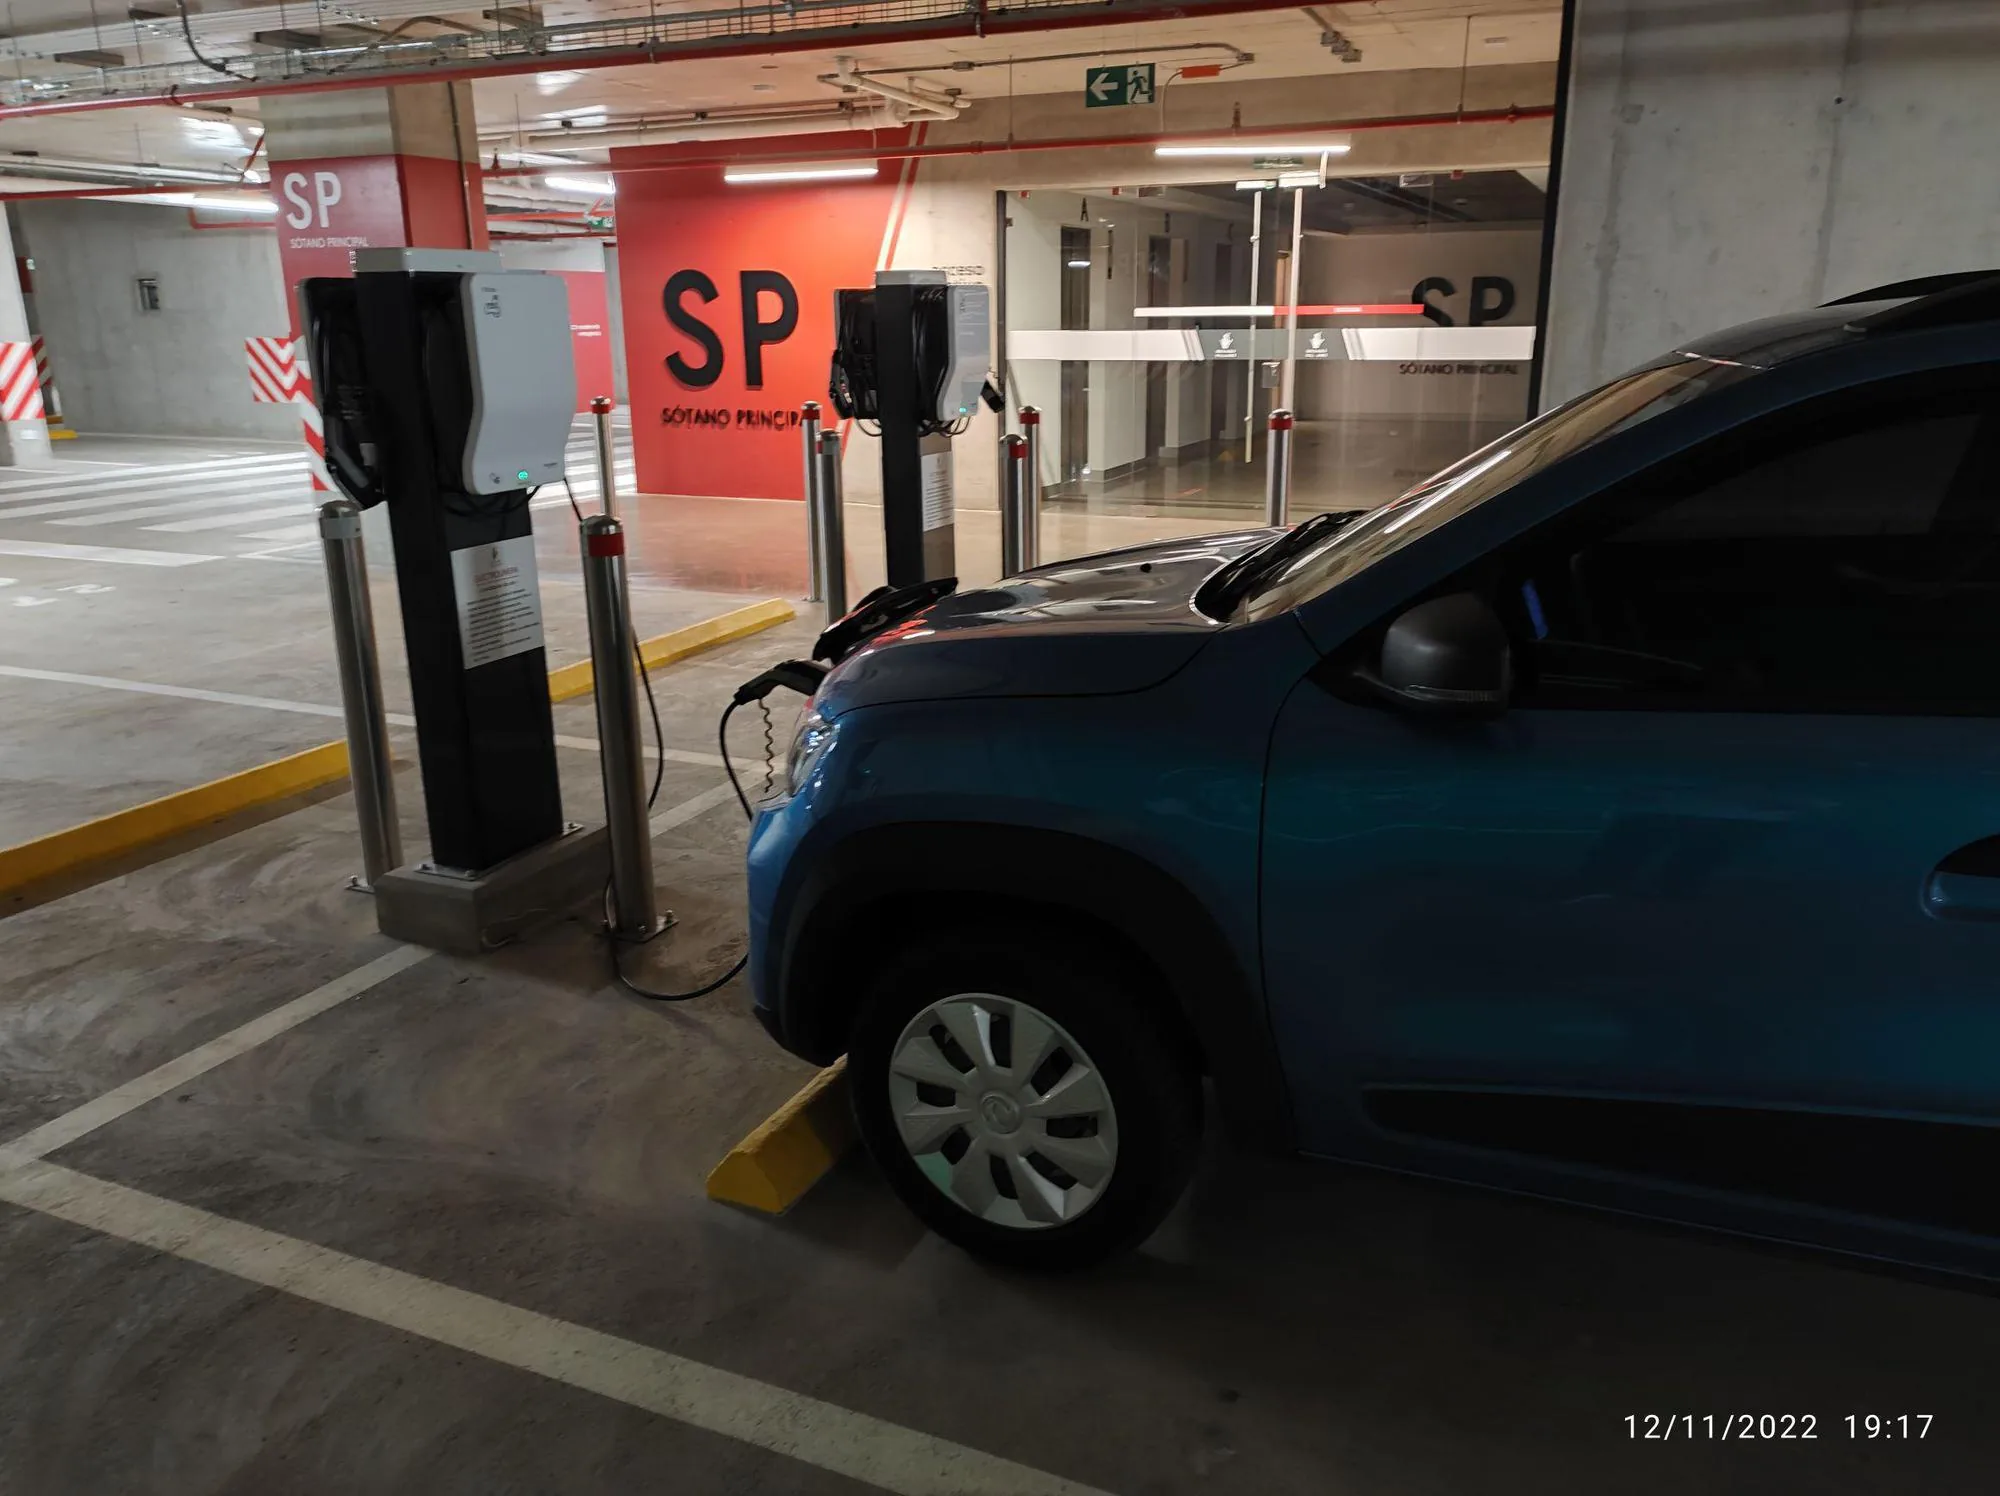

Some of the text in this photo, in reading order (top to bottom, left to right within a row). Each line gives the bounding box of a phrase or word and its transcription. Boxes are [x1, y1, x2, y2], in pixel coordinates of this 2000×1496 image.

[283, 172, 341, 230] SP
[1411, 276, 1515, 327] SP
[663, 269, 799, 390] SP
[661, 405, 803, 430] SÓTANO PRINCIP
